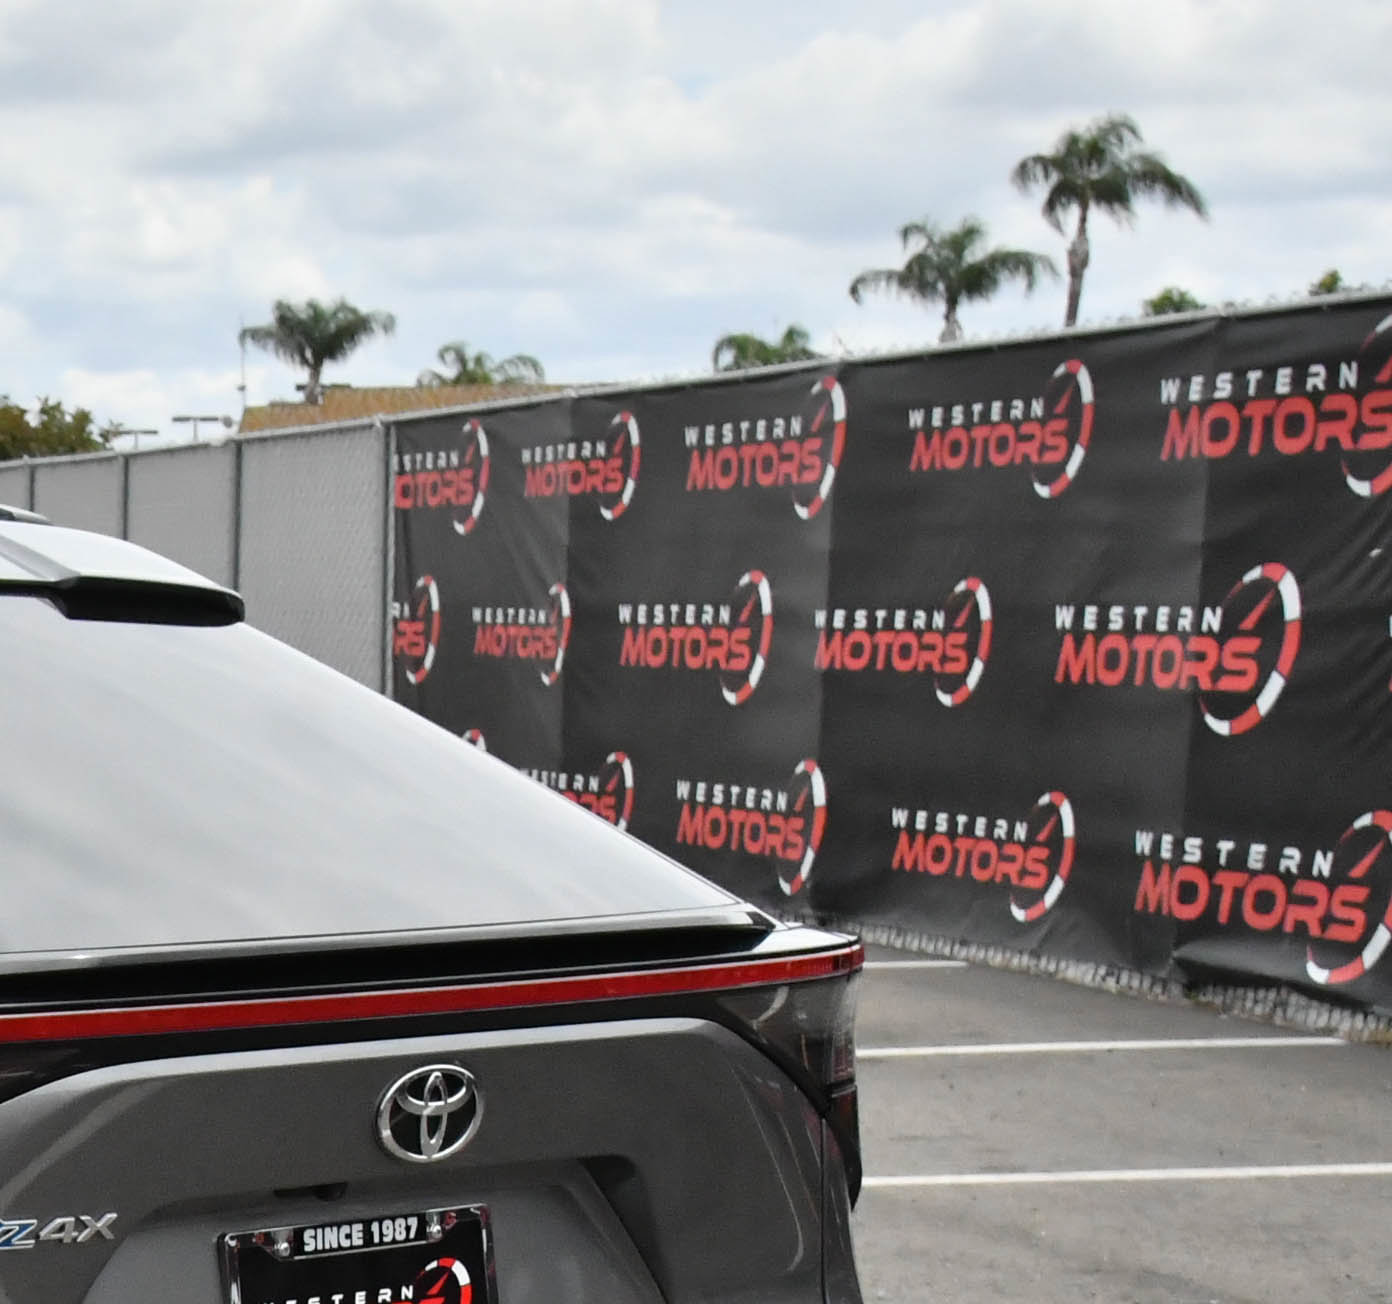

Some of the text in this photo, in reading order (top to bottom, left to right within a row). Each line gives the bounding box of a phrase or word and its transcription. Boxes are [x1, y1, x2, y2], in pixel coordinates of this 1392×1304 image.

[1160, 361, 1359, 404] WESTERN
[684, 416, 802, 448] WESTERN
[908, 398, 1045, 428] WESTERN
[1159, 390, 1392, 461] MOTORS
[521, 441, 606, 464] WESTERN
[685, 437, 823, 491] MOTORS
[909, 418, 1069, 471] MOTORS
[524, 457, 624, 497] MOTORS
[472, 606, 547, 625] WESTERN
[618, 604, 731, 625] WESTERN
[814, 608, 946, 630] WESTERN
[1055, 604, 1224, 632] WESTERN
[473, 624, 558, 659] MOTORS
[619, 625, 752, 671] MOTORS
[814, 629, 969, 674] MOTORS
[1054, 632, 1262, 693] MOTORS
[676, 780, 788, 811] WESTERN
[676, 804, 805, 861] MOTORS
[891, 807, 1028, 842] WESTERN
[891, 831, 1051, 890] MOTORS
[1134, 830, 1335, 878] WESTERN
[1134, 860, 1371, 943] MOTORS
[303, 1217, 418, 1251] SINCE 1987
